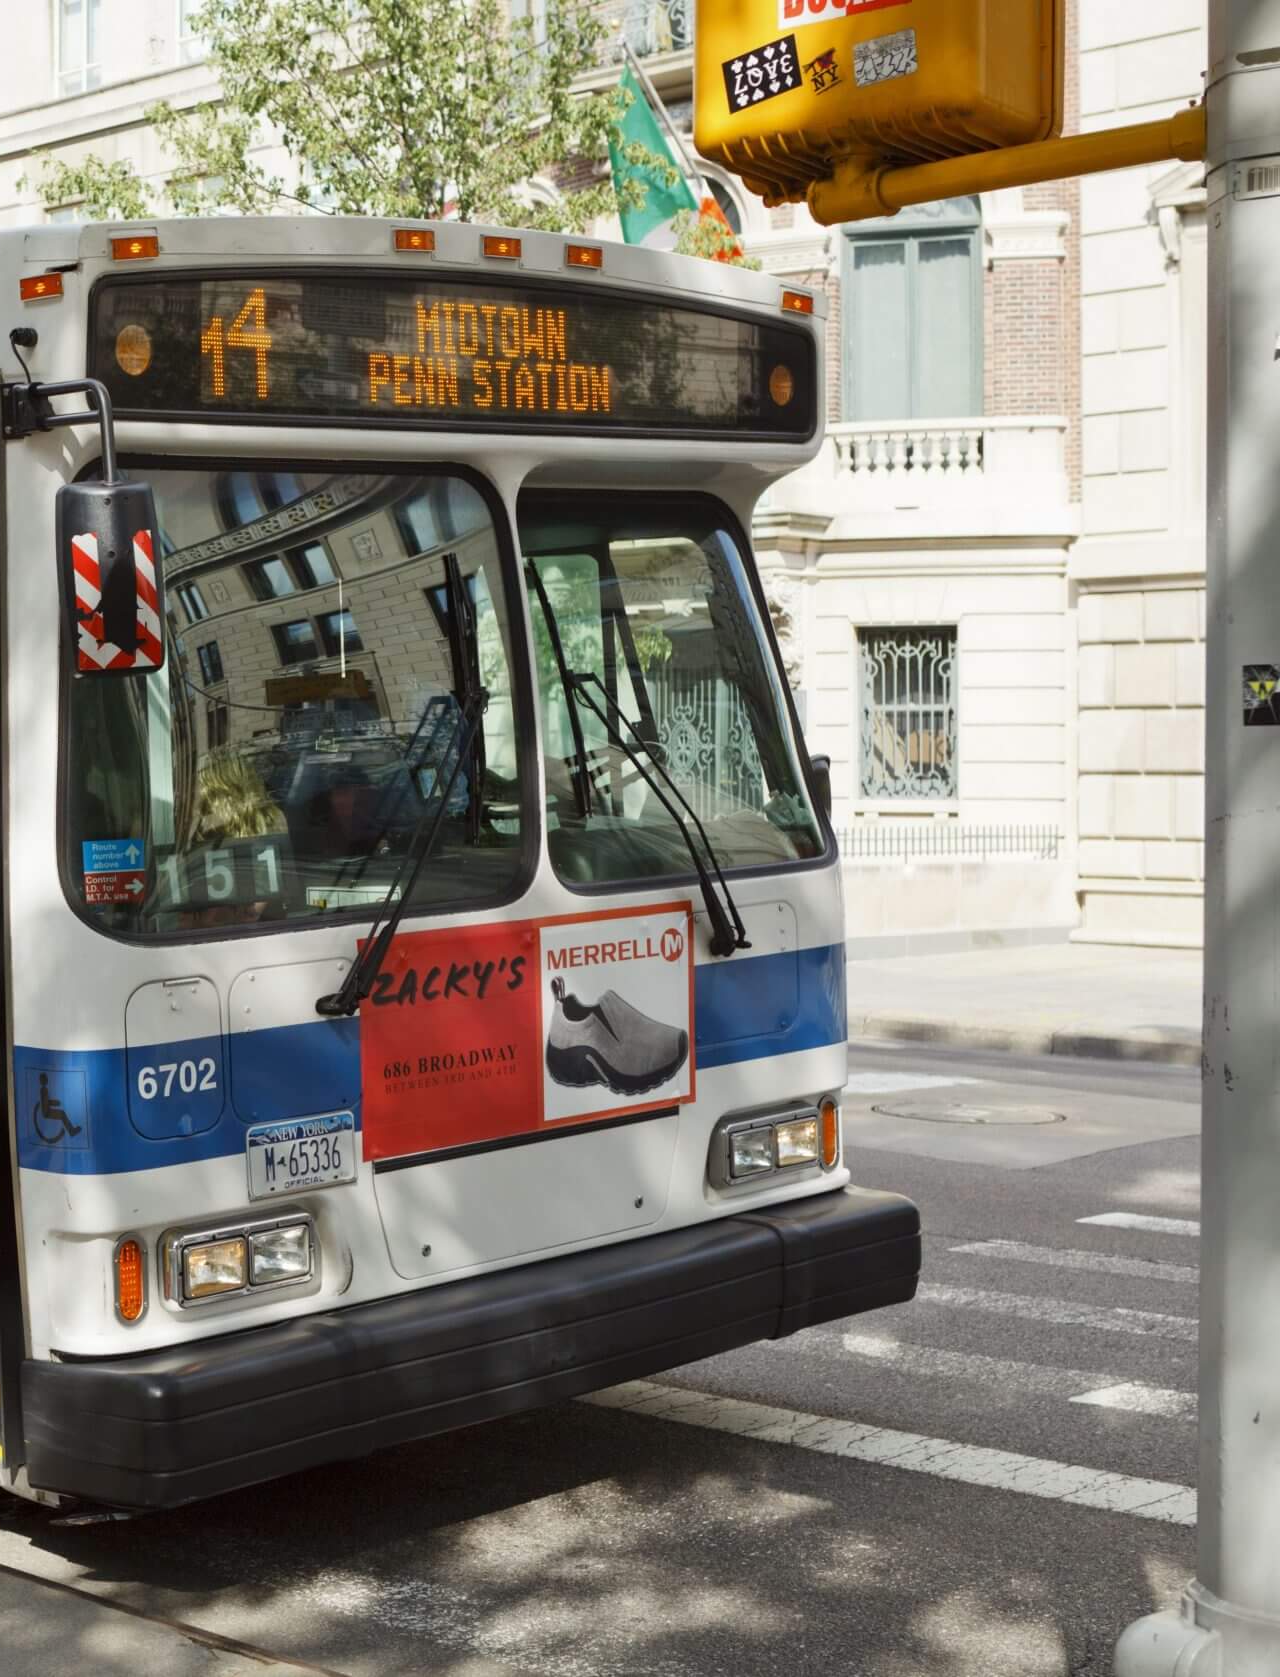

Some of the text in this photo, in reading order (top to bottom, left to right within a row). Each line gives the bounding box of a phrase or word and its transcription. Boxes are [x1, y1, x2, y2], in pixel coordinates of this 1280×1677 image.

[416, 300, 567, 360] MIDTOWN
[368, 352, 611, 412] PENN STATION
[91, 843, 117, 851] Route
[85, 873, 117, 885] Control
[547, 937, 660, 970] MERRELL
[371, 956, 526, 1008] ZACKY'S
[138, 1057, 217, 1100] 6702
[383, 1045, 518, 1079] 686 BROADWAY
[275, 1120, 328, 1140] NEW YORK
[289, 1136, 341, 1177] 65336
[284, 1176, 325, 1189] OFFICIAL
